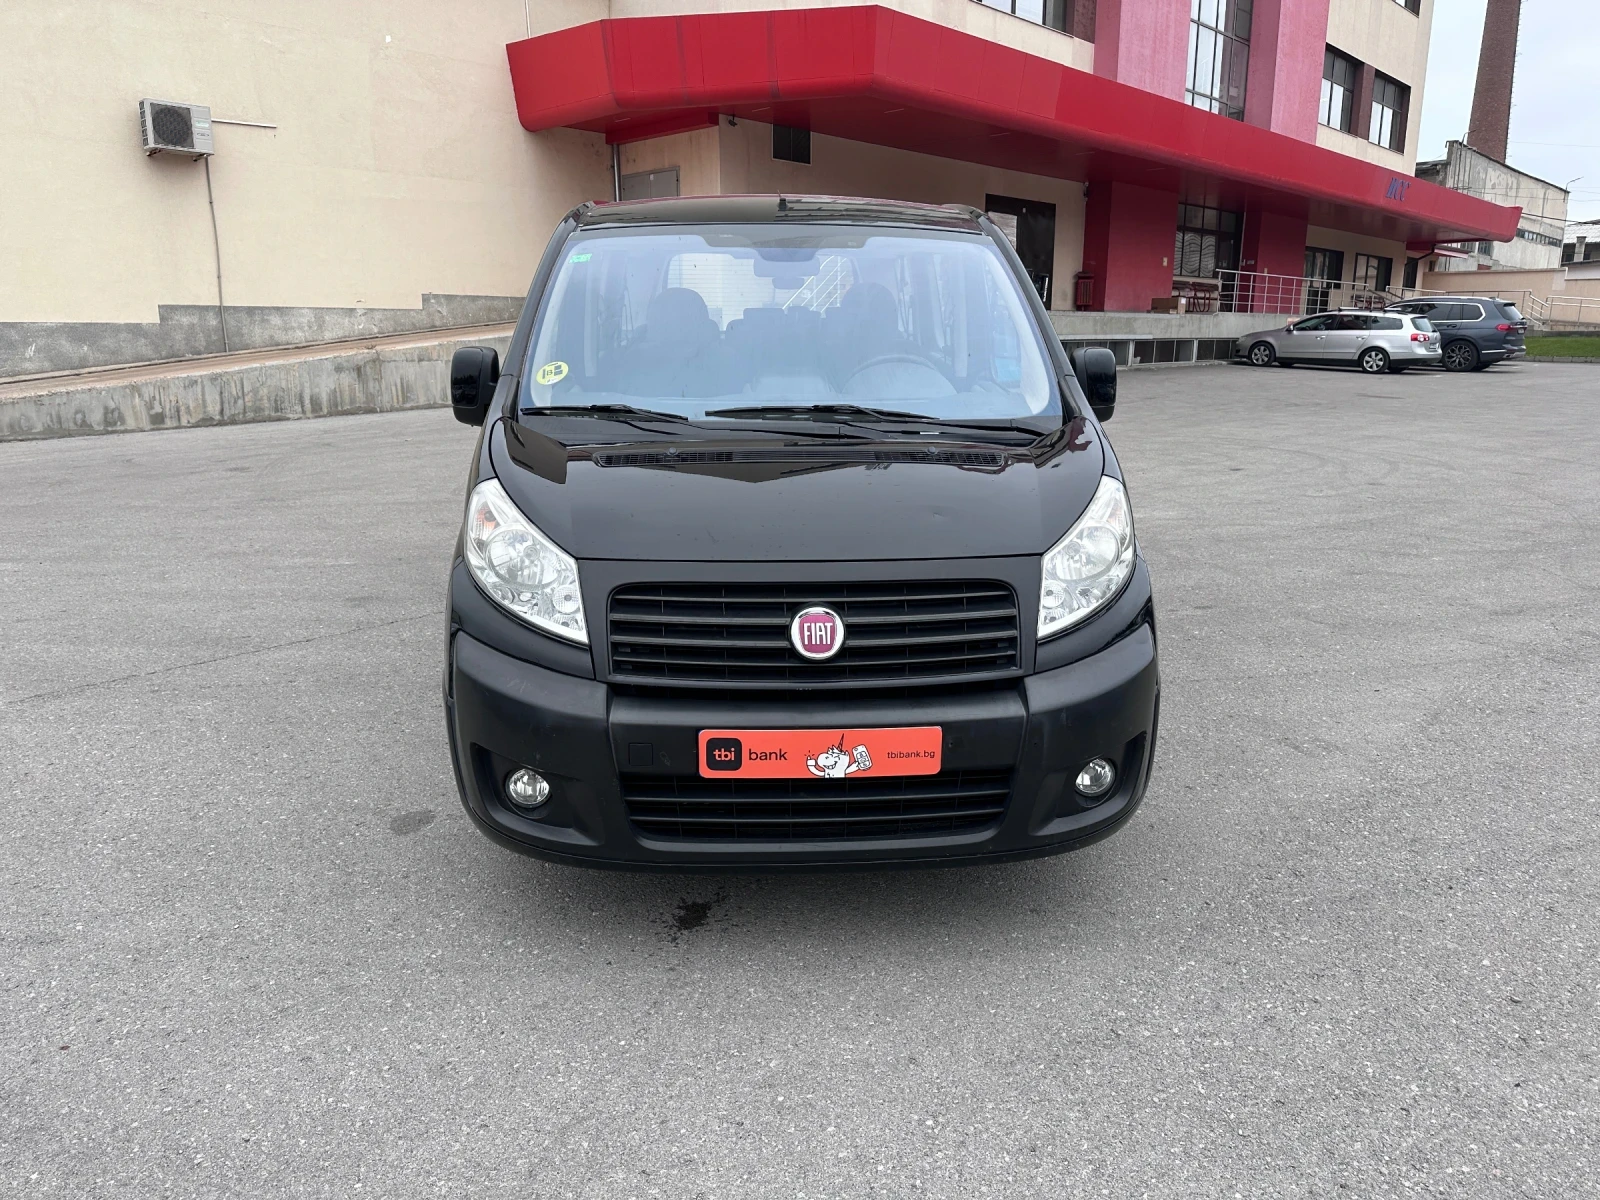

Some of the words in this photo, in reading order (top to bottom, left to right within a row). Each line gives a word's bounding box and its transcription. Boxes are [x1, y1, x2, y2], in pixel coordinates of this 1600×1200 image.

[803, 622, 833, 645] FIAT
[713, 747, 735, 761] tbi
[748, 748, 788, 761] bank
[887, 750, 935, 759] tbibank.bg
